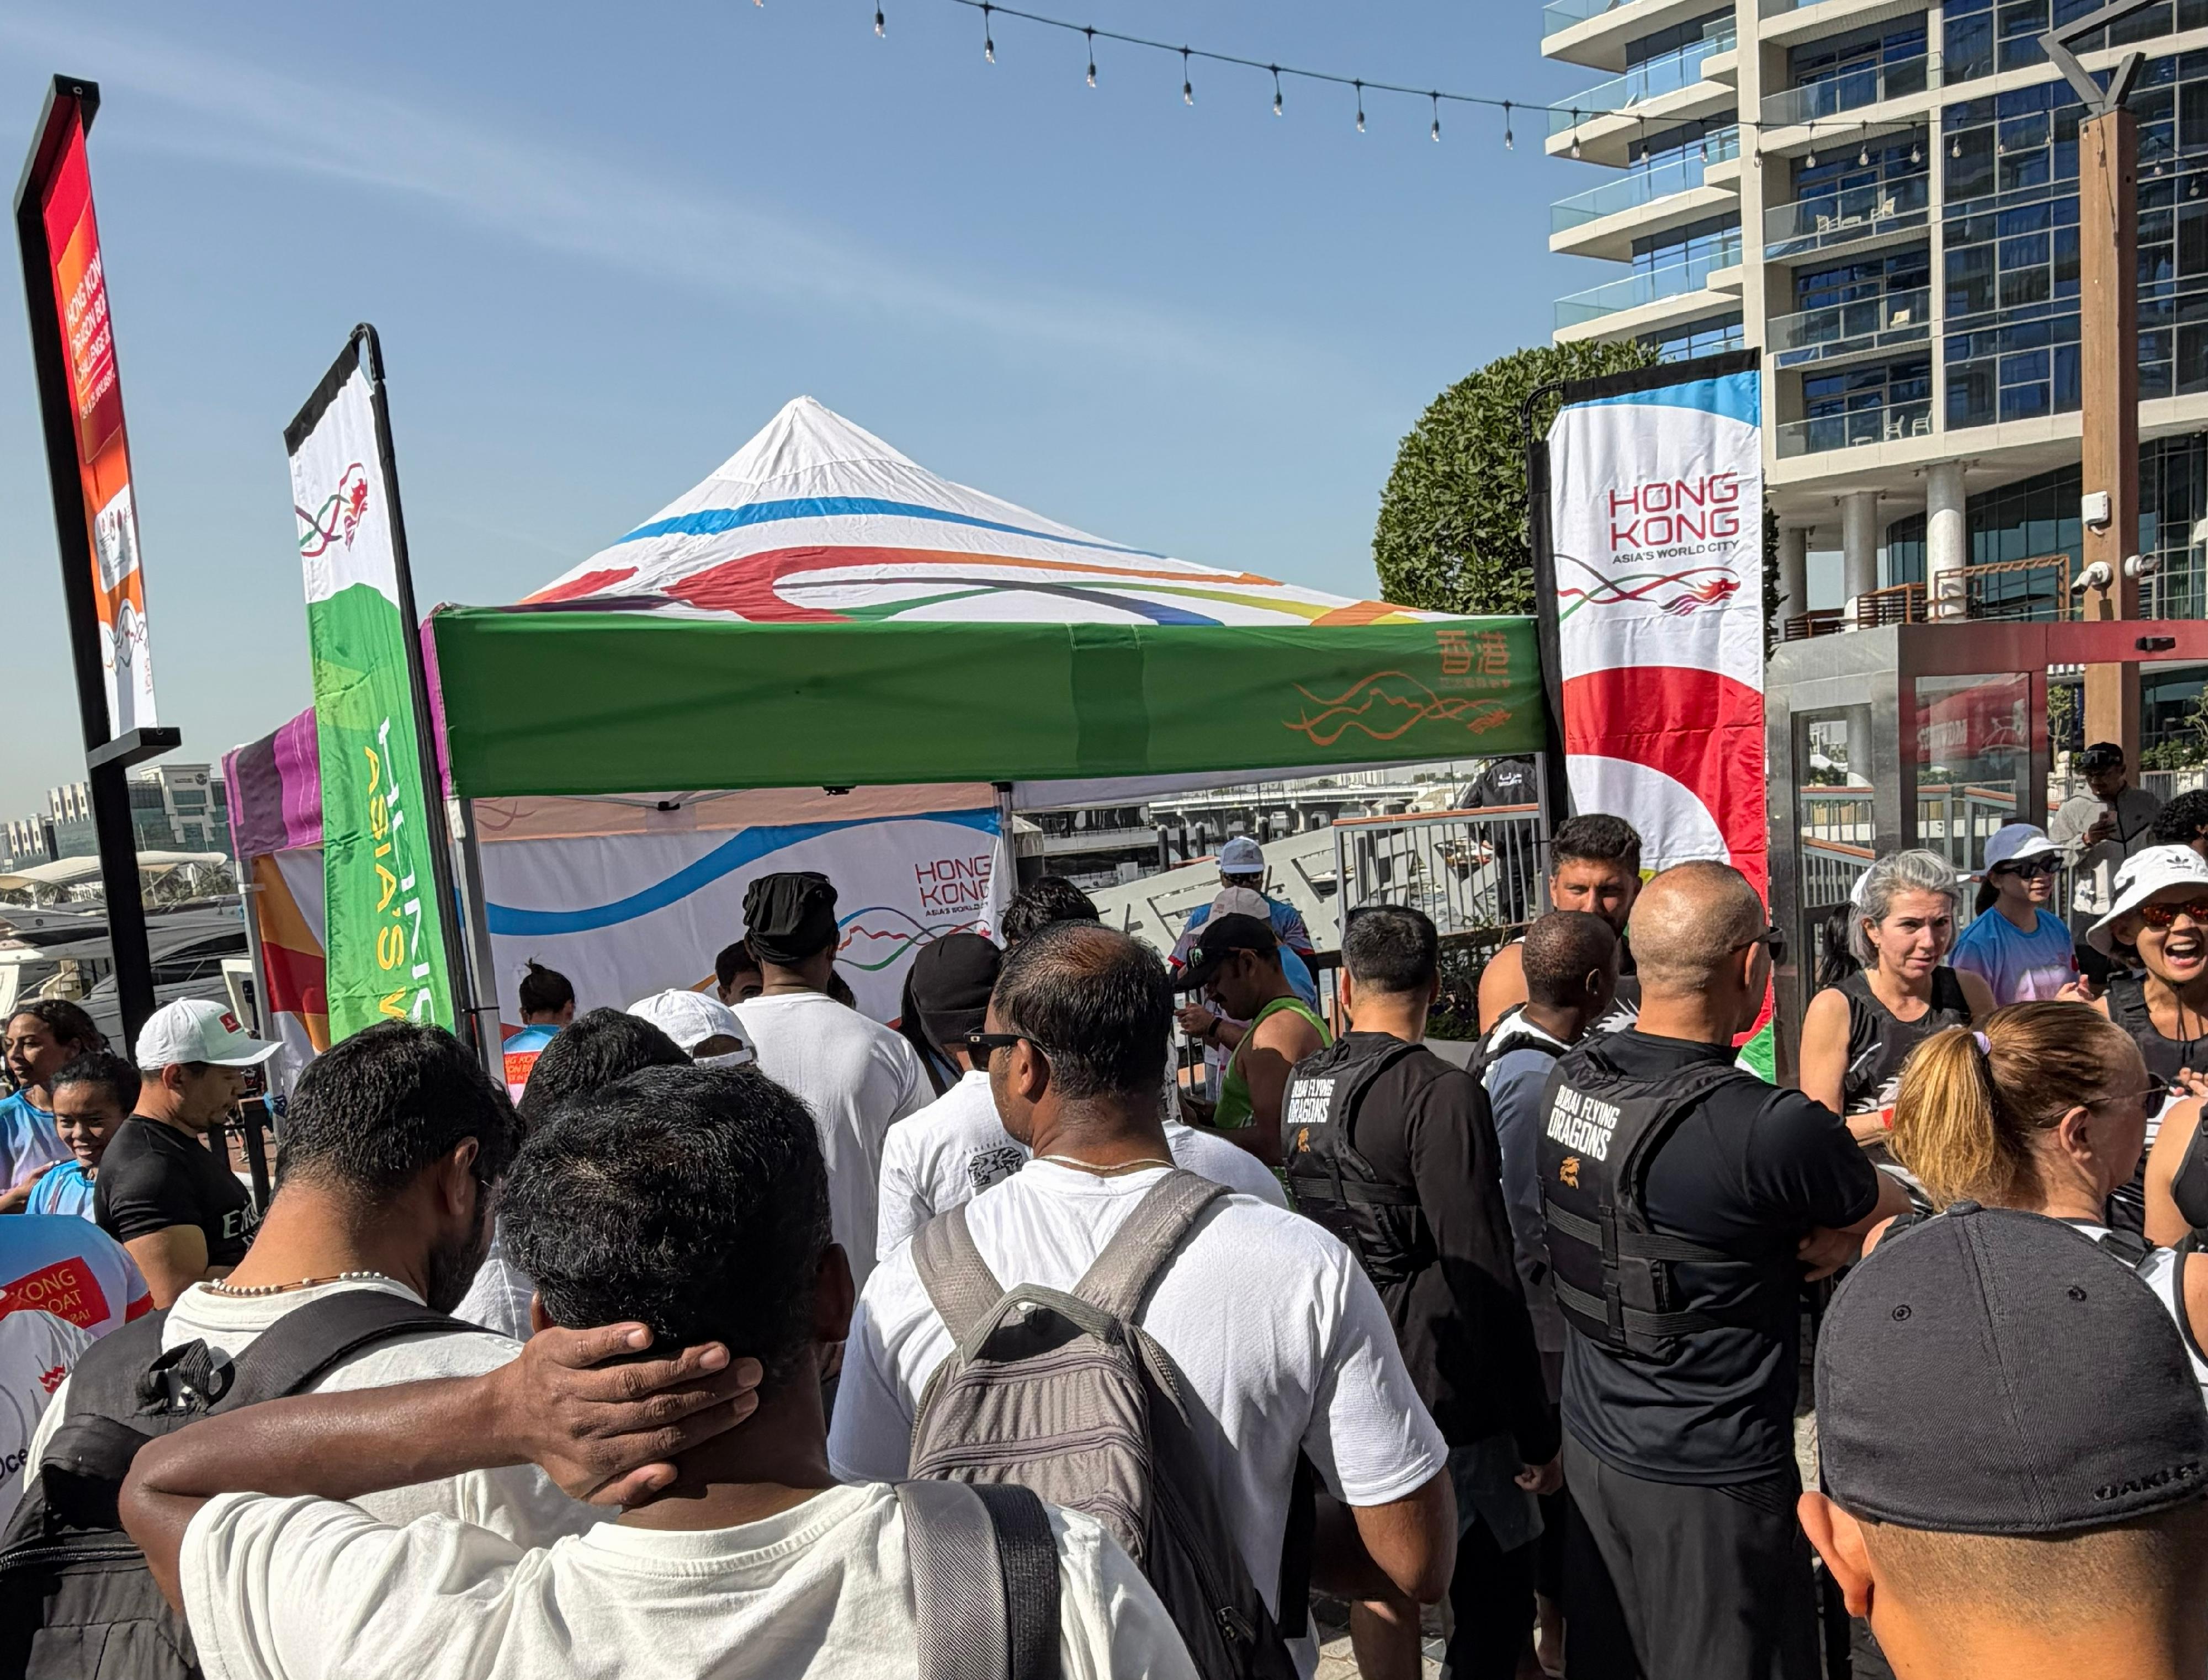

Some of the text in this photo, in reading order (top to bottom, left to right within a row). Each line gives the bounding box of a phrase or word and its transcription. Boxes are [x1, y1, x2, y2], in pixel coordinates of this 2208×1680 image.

[84, 246, 102, 300] KON
[1609, 471, 1739, 518] HONG
[1610, 505, 1740, 551] KONG
[1612, 539, 1740, 565] ASIA'S WORLD CITY
[1436, 630, 1511, 674] 香港
[364, 746, 405, 971] ASIA'S
[915, 855, 992, 884] HONG
[1287, 1097, 1330, 1123] DRAGONS
[1554, 1084, 1621, 1130] DUBAI FLYING
[1546, 1107, 1612, 1162] DRAGONS
[39, 1289, 82, 1314] OAT
